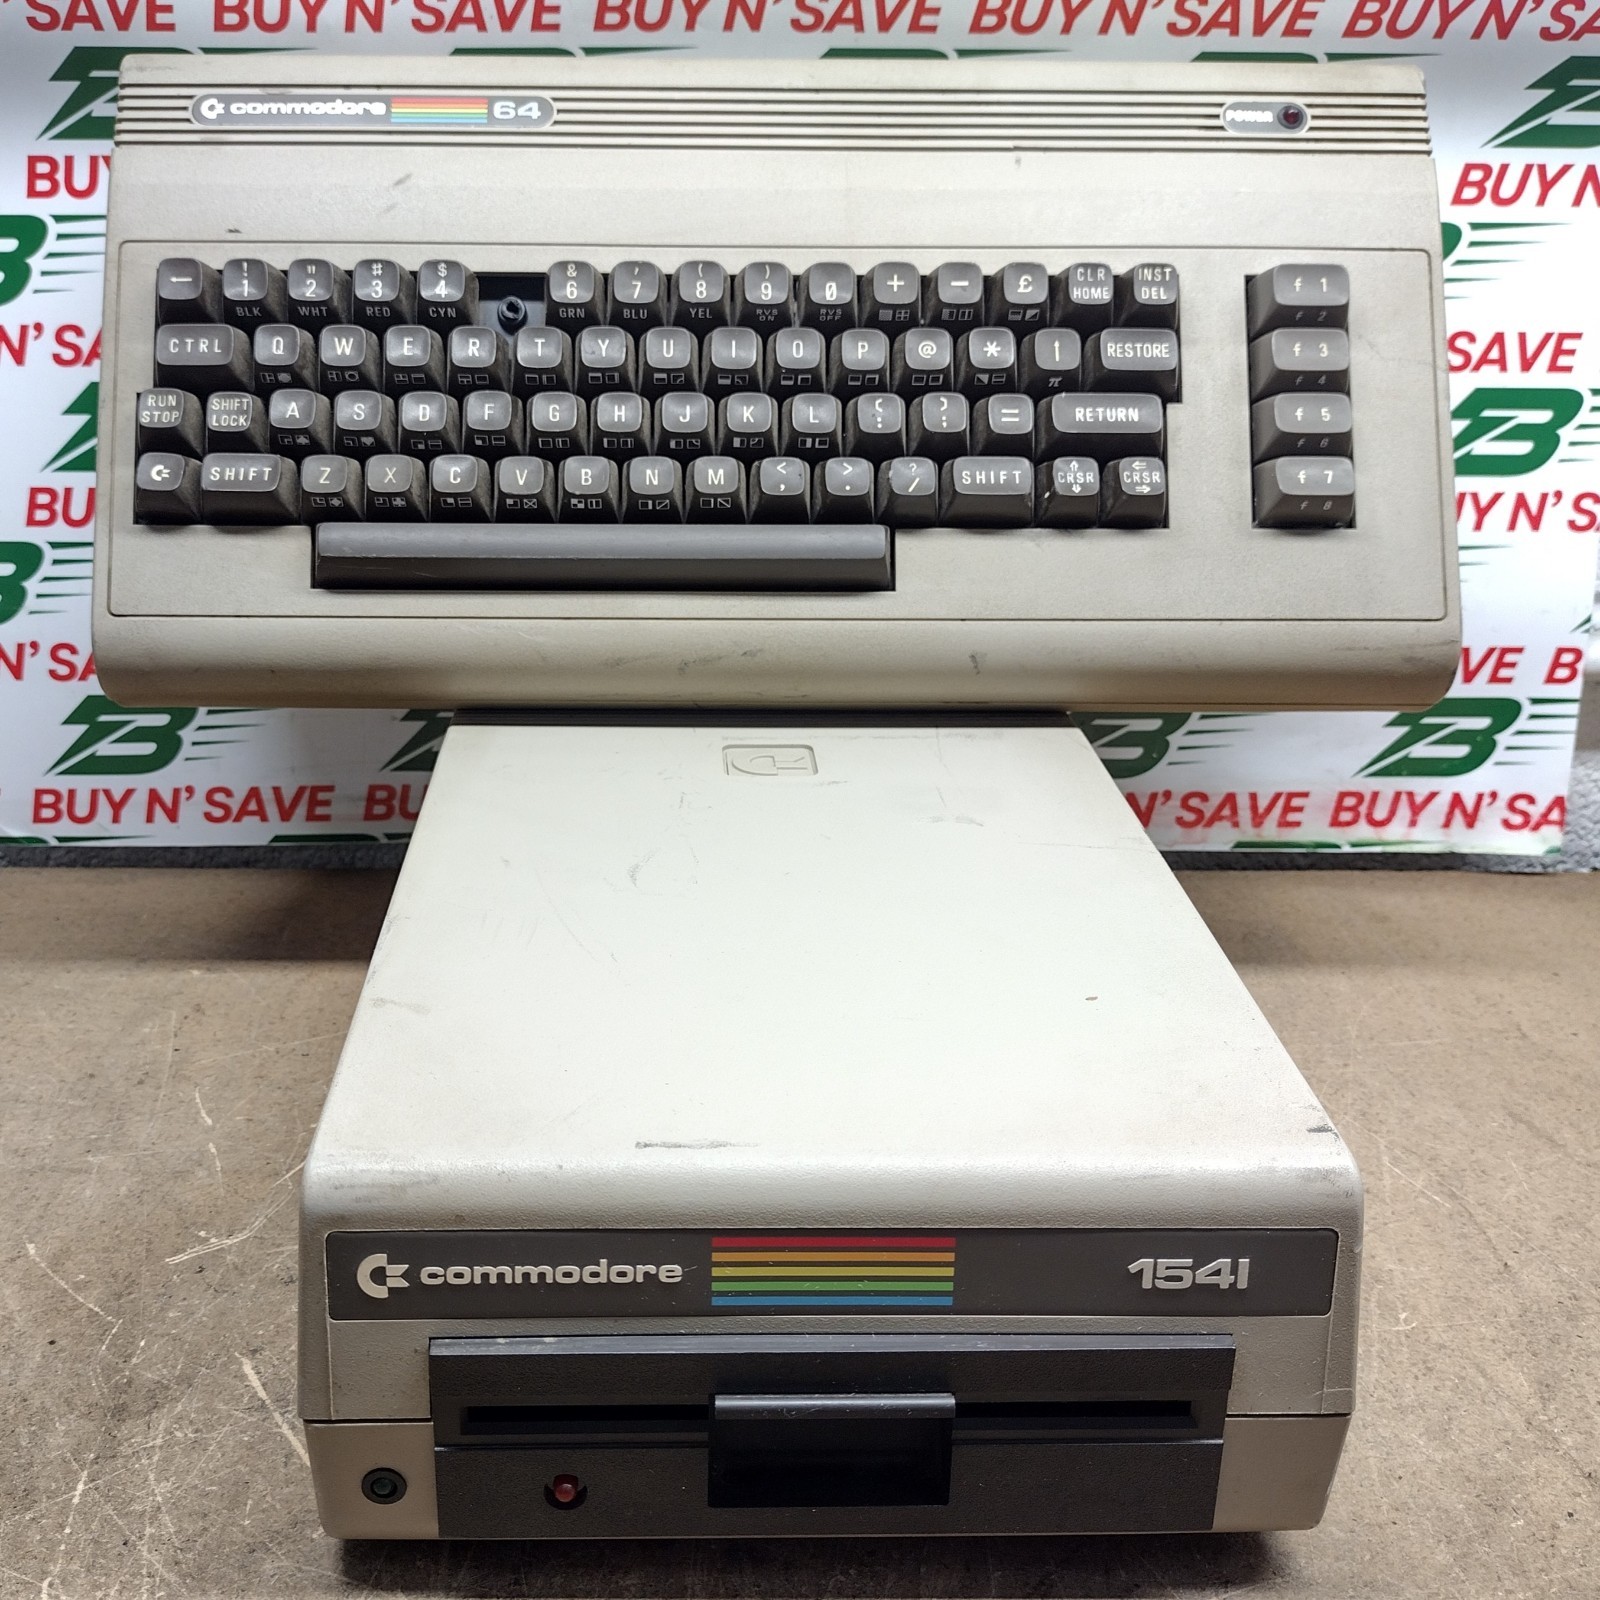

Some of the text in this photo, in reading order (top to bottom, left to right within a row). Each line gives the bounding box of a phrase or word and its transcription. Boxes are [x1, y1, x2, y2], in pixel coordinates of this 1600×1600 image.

[26, 0, 176, 32] SAVE
[214, 0, 326, 33] BUY
[411, 0, 562, 34] SAVE
[593, 0, 708, 33] BUY
[789, 0, 941, 34] SAVE
[968, 0, 1088, 35] BUY
[1166, 0, 1326, 38] SAVE
[1341, 0, 1472, 40] BUY
[230, 99, 541, 120] commodore 64
[27, 154, 111, 199] BU
[1450, 163, 1575, 208] BUY
[372, 263, 383, 276] #
[437, 263, 447, 277] $
[567, 264, 577, 277] &
[1077, 268, 1105, 281] CLR
[1139, 269, 1172, 280] INST
[242, 281, 249, 296] 1
[306, 281, 316, 296] 2
[371, 281, 383, 298] 3
[435, 281, 448, 297] 4
[566, 282, 578, 299] 6
[632, 282, 642, 299] 7
[696, 282, 706, 299] 8
[887, 274, 904, 292] +
[1017, 275, 1032, 292] £
[761, 283, 772, 300] 9
[1074, 287, 1110, 299] HOME
[1142, 288, 1167, 299] DEL
[237, 306, 261, 317] BLK
[299, 306, 328, 317] WHT
[366, 306, 390, 317] RED
[429, 307, 456, 318] CYN
[559, 308, 585, 318] GRN
[623, 309, 647, 319] BLU
[689, 309, 712, 319] YEL
[170, 340, 222, 353] CTRL
[272, 338, 284, 355] Q
[335, 338, 353, 356] W
[403, 339, 414, 356] E
[468, 339, 480, 357] R
[534, 339, 546, 356] T
[598, 340, 609, 357] Y
[663, 340, 674, 357] U
[858, 343, 868, 359] P
[918, 341, 936, 358] @
[1107, 342, 1170, 357] RESTORE
[1447, 331, 1583, 374] SAVE
[148, 395, 176, 407] RUN
[212, 398, 249, 411] SHIFT
[142, 410, 179, 423] STOP
[286, 402, 299, 418] A
[353, 404, 365, 420] S
[420, 405, 430, 421] D
[484, 404, 494, 420] F
[549, 405, 560, 422] G
[614, 406, 626, 422] H
[679, 405, 690, 423] J
[743, 406, 754, 423] K
[809, 406, 819, 423] L
[1001, 409, 1019, 422] =
[1076, 408, 1139, 422] RETURN
[212, 414, 247, 427] LOCK
[210, 468, 272, 481] SHIFT
[320, 468, 330, 483] Z
[384, 468, 396, 482] X
[450, 467, 461, 483] C
[581, 469, 592, 485] B
[708, 469, 724, 485] M
[909, 463, 917, 475] ?
[1124, 472, 1160, 482] CRSR
[516, 469, 527, 486] V
[646, 469, 658, 486] N
[962, 472, 1021, 484] SHIFT
[1058, 473, 1094, 483] CRSR
[1507, 491, 1563, 532] N'
[32, 788, 136, 824] BUY
[145, 785, 194, 824] N'
[203, 785, 335, 823] SAVE
[1175, 791, 1309, 829] SAVE
[1329, 791, 1442, 830] BUY
[1446, 791, 1501, 831] N'
[419, 1258, 683, 1285] commodore
